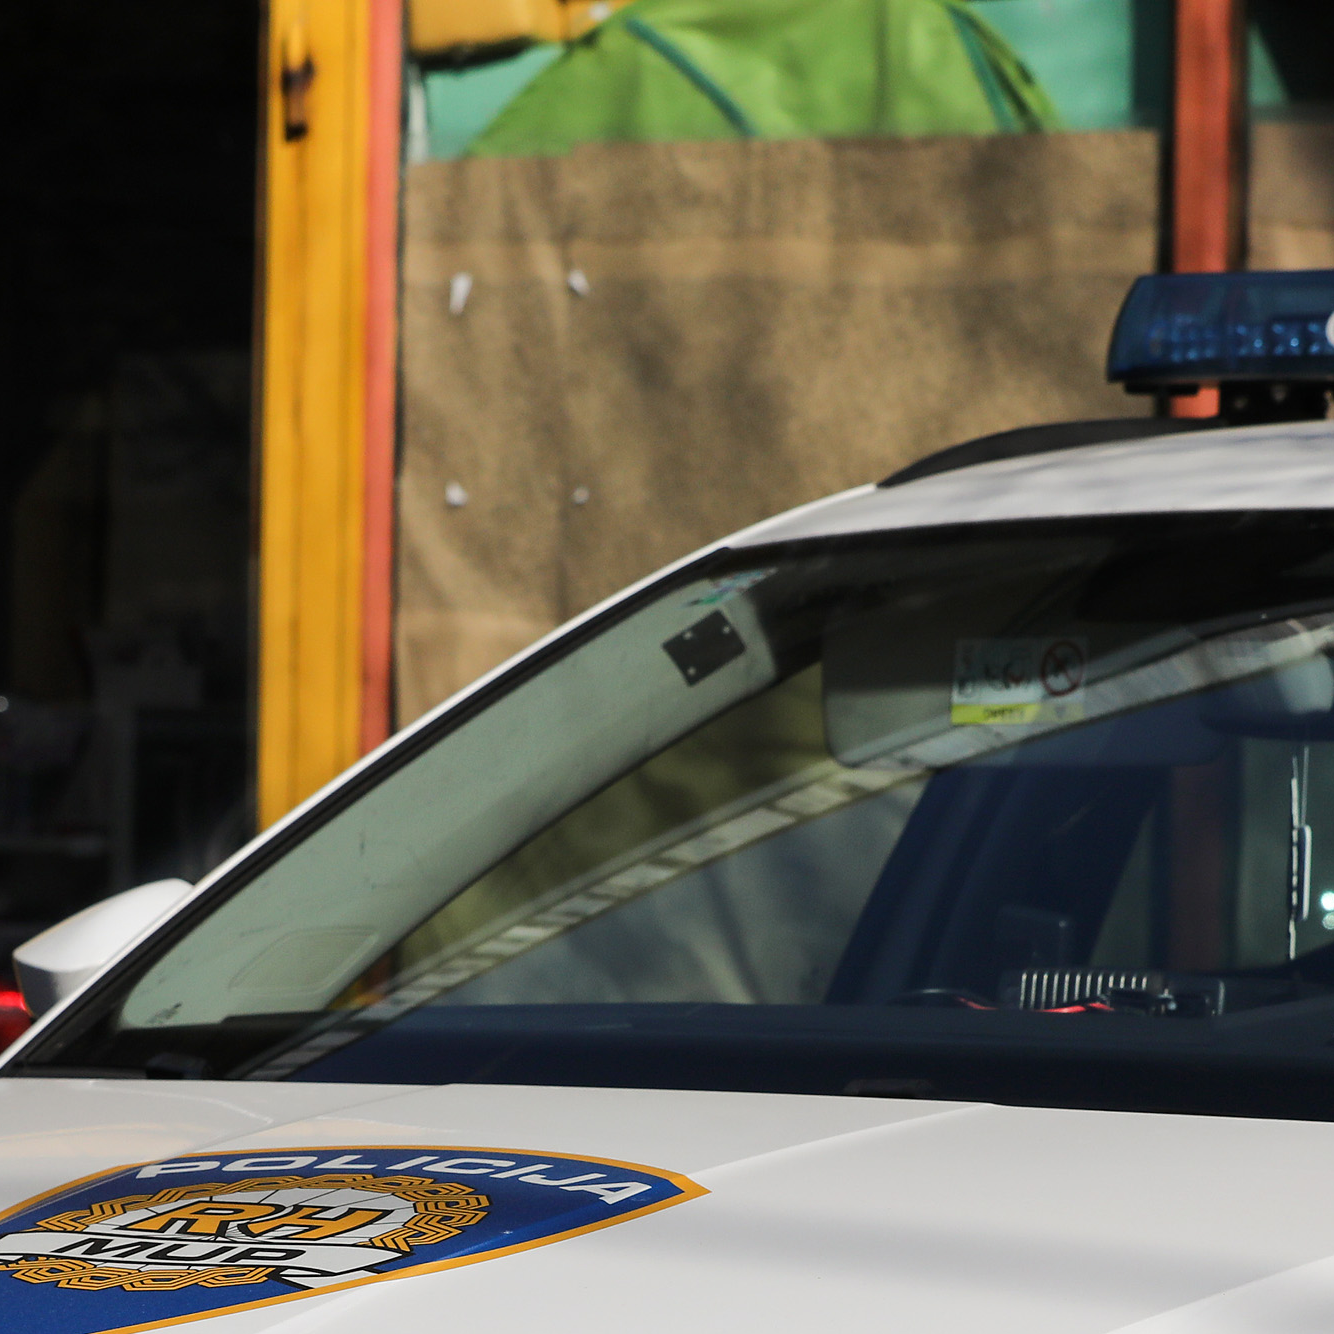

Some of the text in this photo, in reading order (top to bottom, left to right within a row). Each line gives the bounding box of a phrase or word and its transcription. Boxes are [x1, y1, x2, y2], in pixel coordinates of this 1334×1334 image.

[136, 1152, 654, 1206] POLICIJA
[116, 1200, 386, 1242] RH
[50, 1237, 307, 1264] MUP
